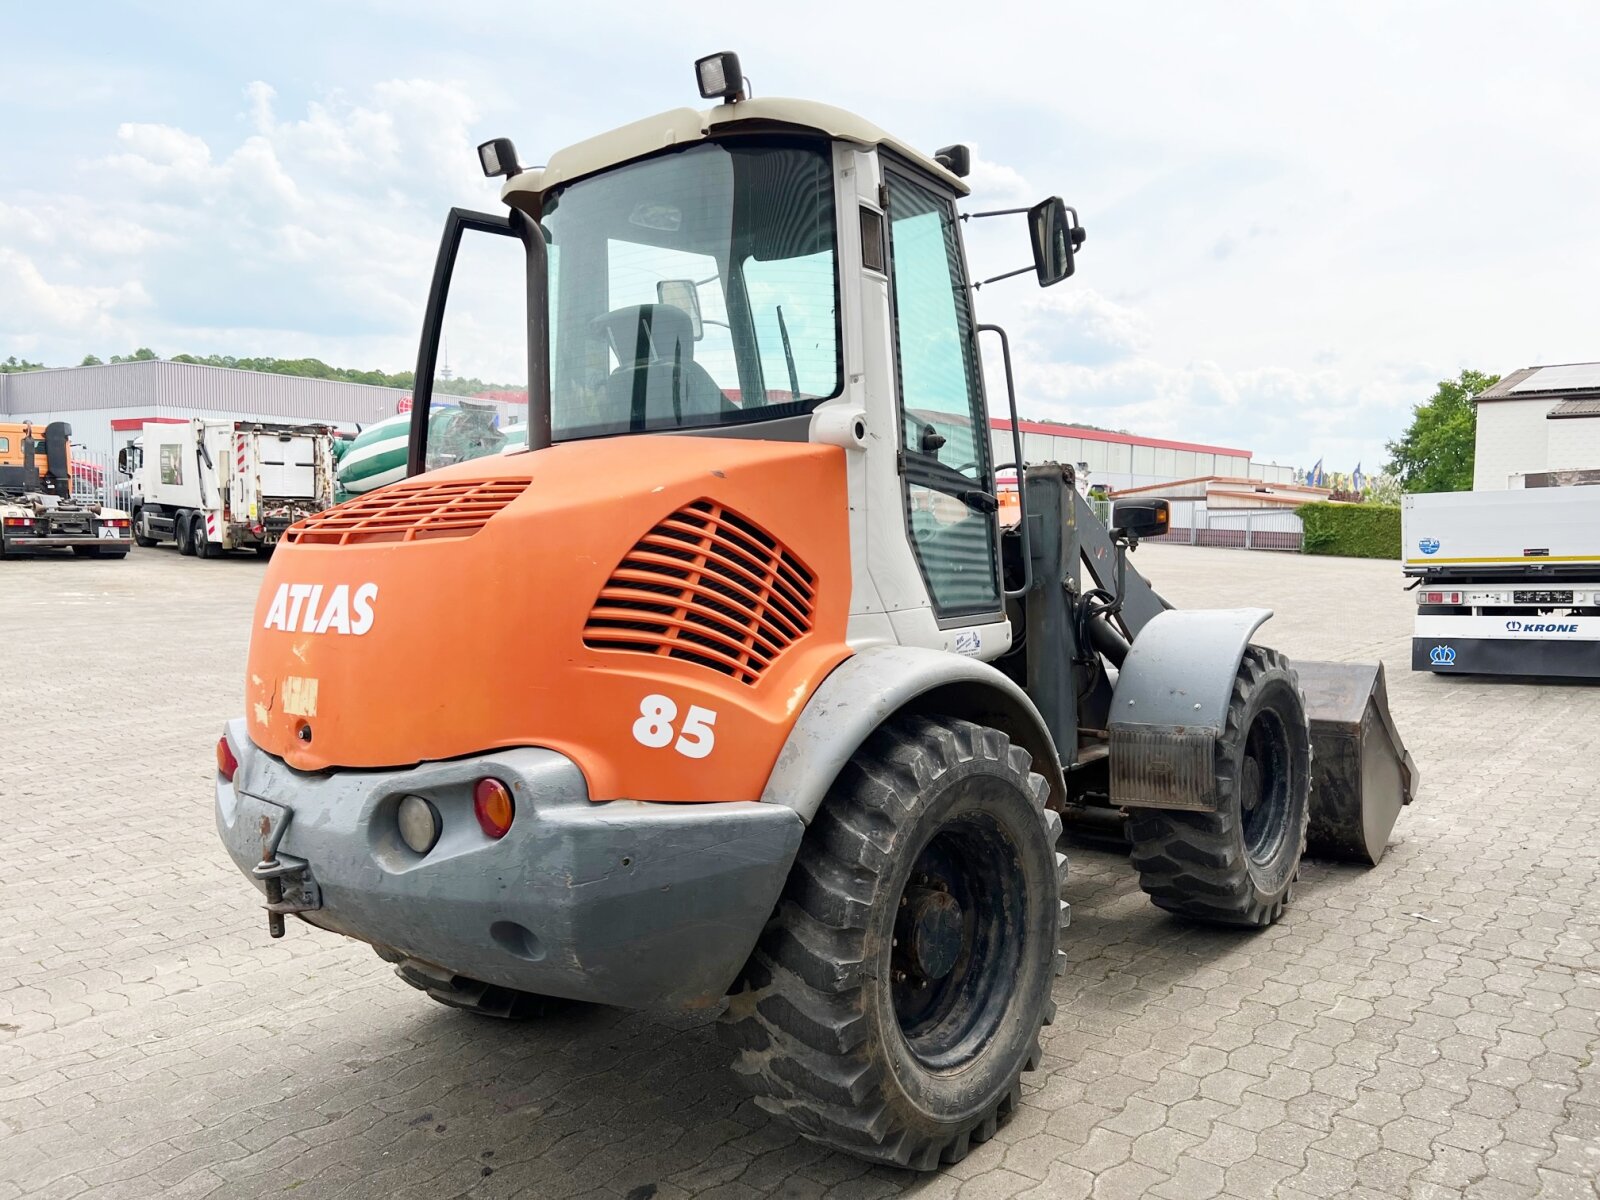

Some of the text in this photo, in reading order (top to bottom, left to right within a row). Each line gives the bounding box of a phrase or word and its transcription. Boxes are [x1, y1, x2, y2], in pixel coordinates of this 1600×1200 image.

[263, 582, 379, 635] ATLAS
[1523, 624, 1579, 633] KRONE
[632, 694, 717, 759] 85
